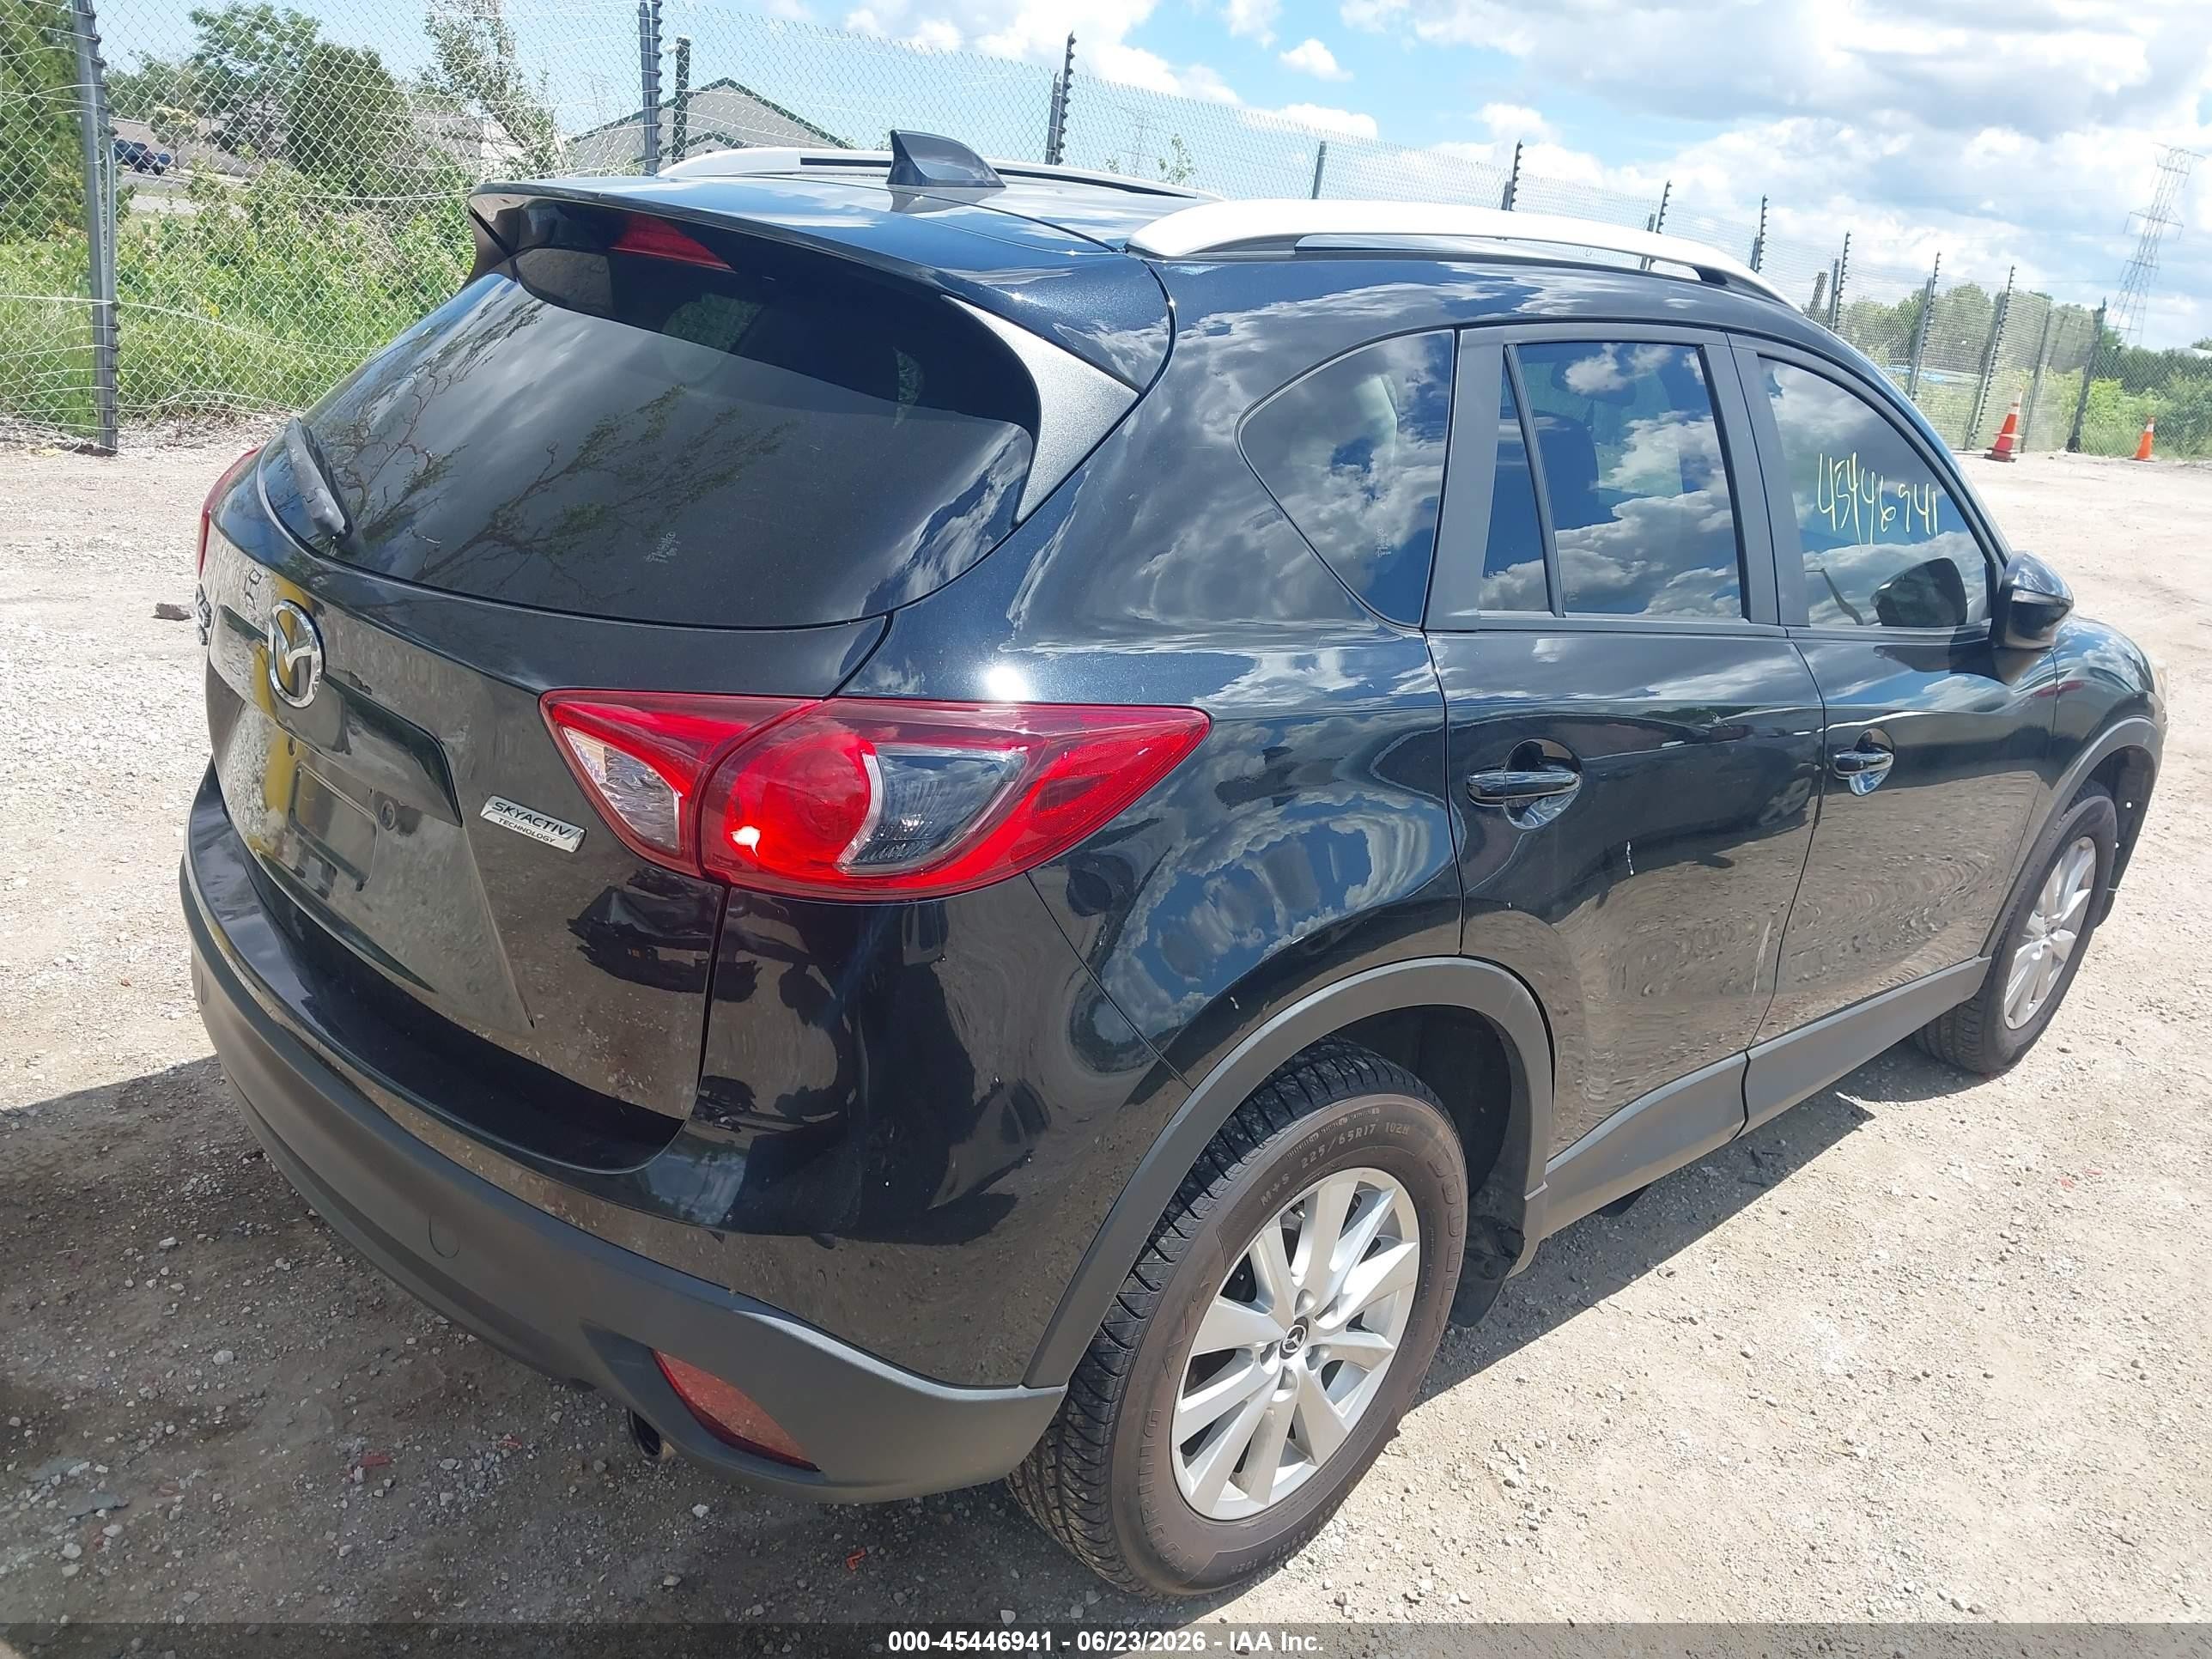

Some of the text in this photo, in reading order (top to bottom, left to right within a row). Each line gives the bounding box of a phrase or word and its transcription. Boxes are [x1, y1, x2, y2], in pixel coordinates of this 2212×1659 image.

[1818, 452, 1937, 552] 45446941
[492, 802, 571, 836] SKYACTIV
[499, 817, 556, 842] TECHNOLOGY
[1260, 1173, 1290, 1206] M+S
[1301, 1124, 1376, 1169] 225/65R17
